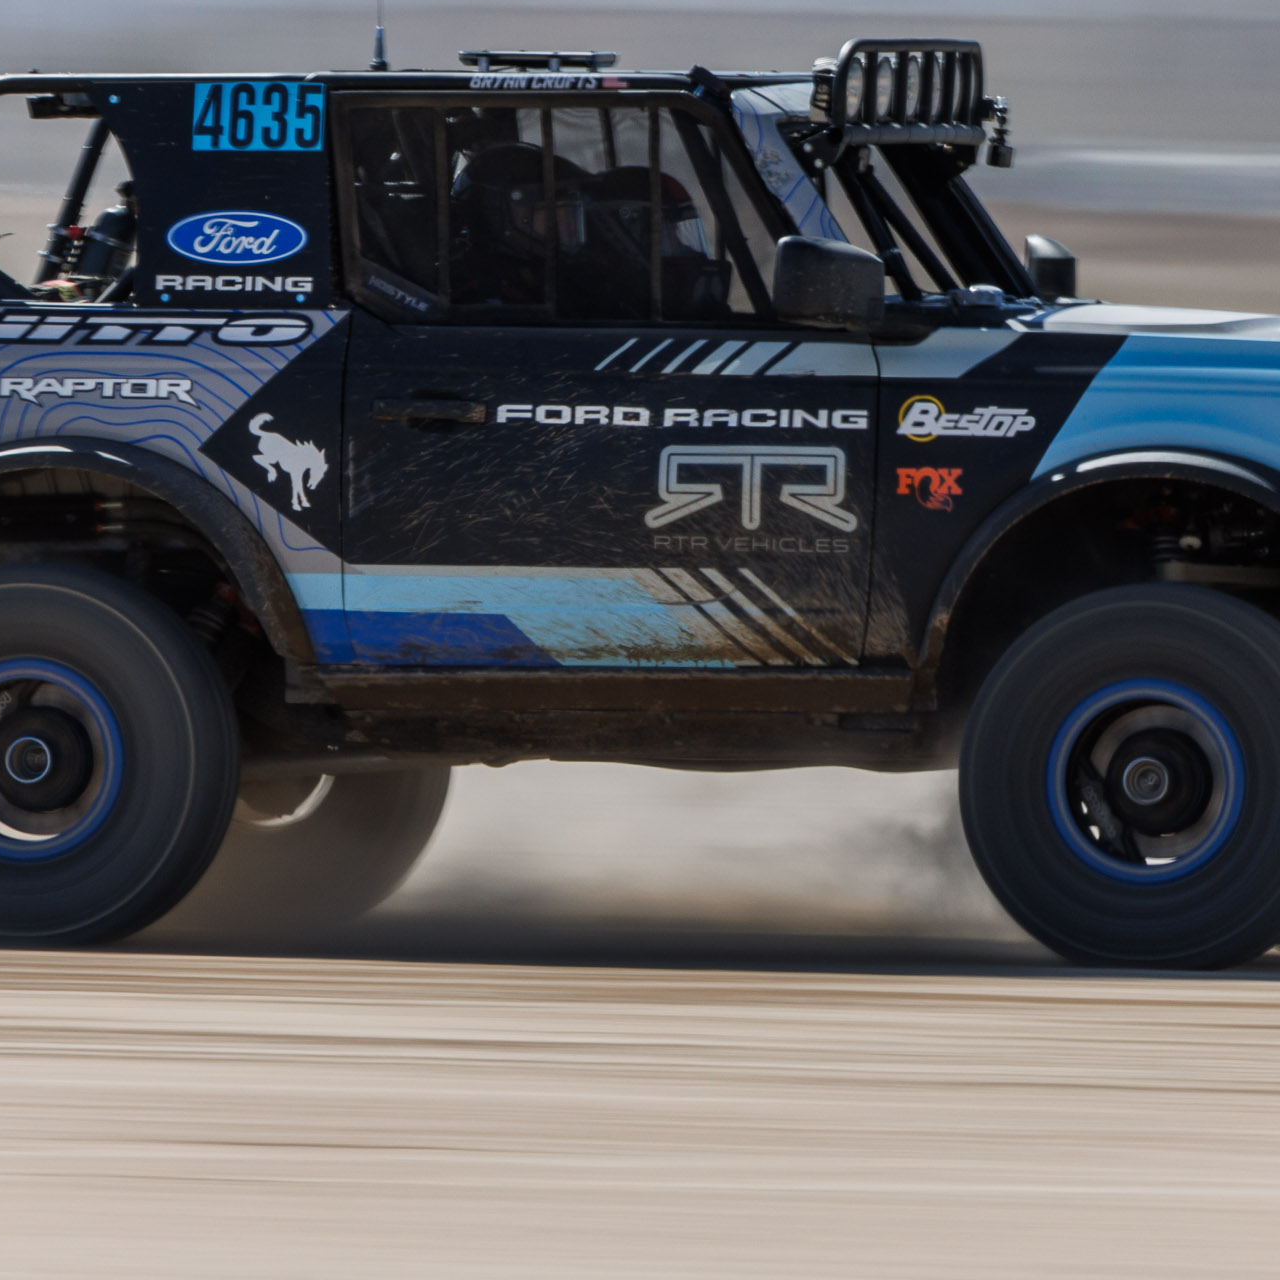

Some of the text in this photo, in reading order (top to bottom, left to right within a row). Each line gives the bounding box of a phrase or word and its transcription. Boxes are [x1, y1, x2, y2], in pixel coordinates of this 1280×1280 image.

[470, 75, 526, 89] BRYAN
[193, 83, 324, 149] 4635
[193, 218, 281, 255] Ford
[156, 275, 313, 293] RACING
[0, 377, 201, 409] RAPTOR
[496, 404, 869, 429] FORD RACING
[896, 467, 963, 509] FOX
[654, 536, 849, 553] RTR VEHICLES
